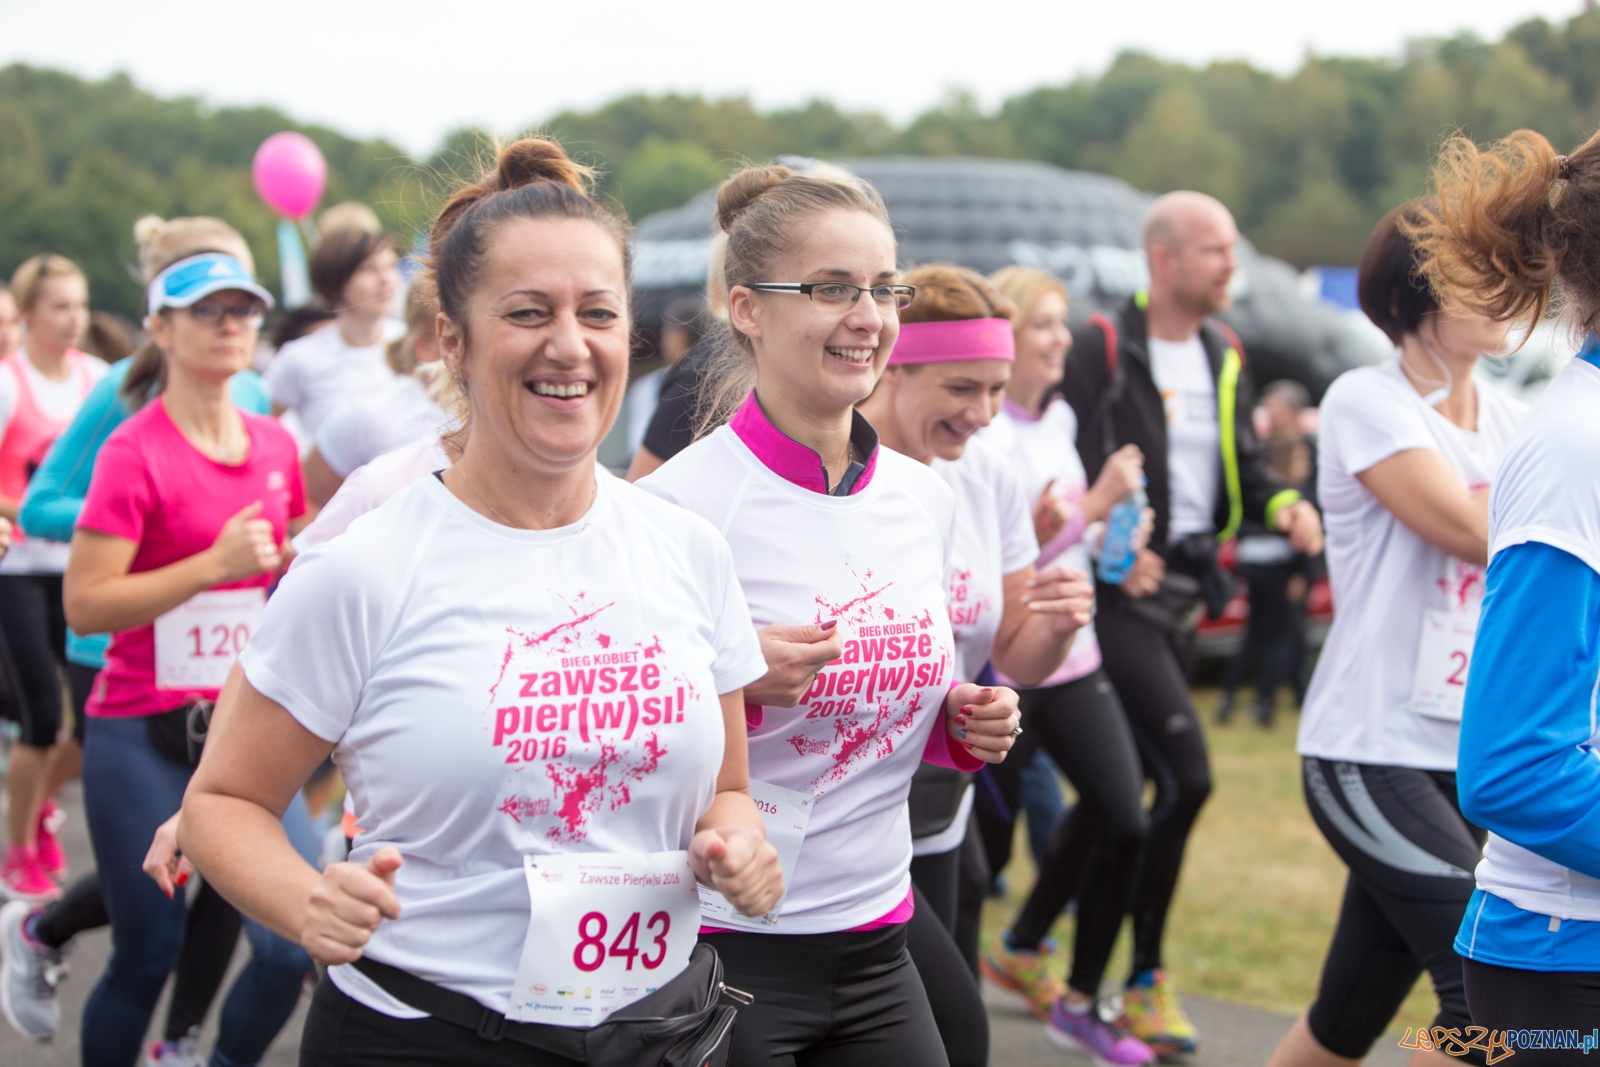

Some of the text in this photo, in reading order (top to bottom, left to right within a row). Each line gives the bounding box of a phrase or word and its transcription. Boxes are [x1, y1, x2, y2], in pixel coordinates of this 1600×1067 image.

[859, 623, 916, 638] BIEG KOBIET
[561, 651, 638, 668] BIEG KOBIET
[519, 663, 661, 698] zawsze
[805, 698, 857, 719] 2016
[504, 736, 567, 764] 2016
[579, 872, 620, 885] Zawsze
[662, 872, 681, 885] 2016
[573, 910, 671, 973] 843
